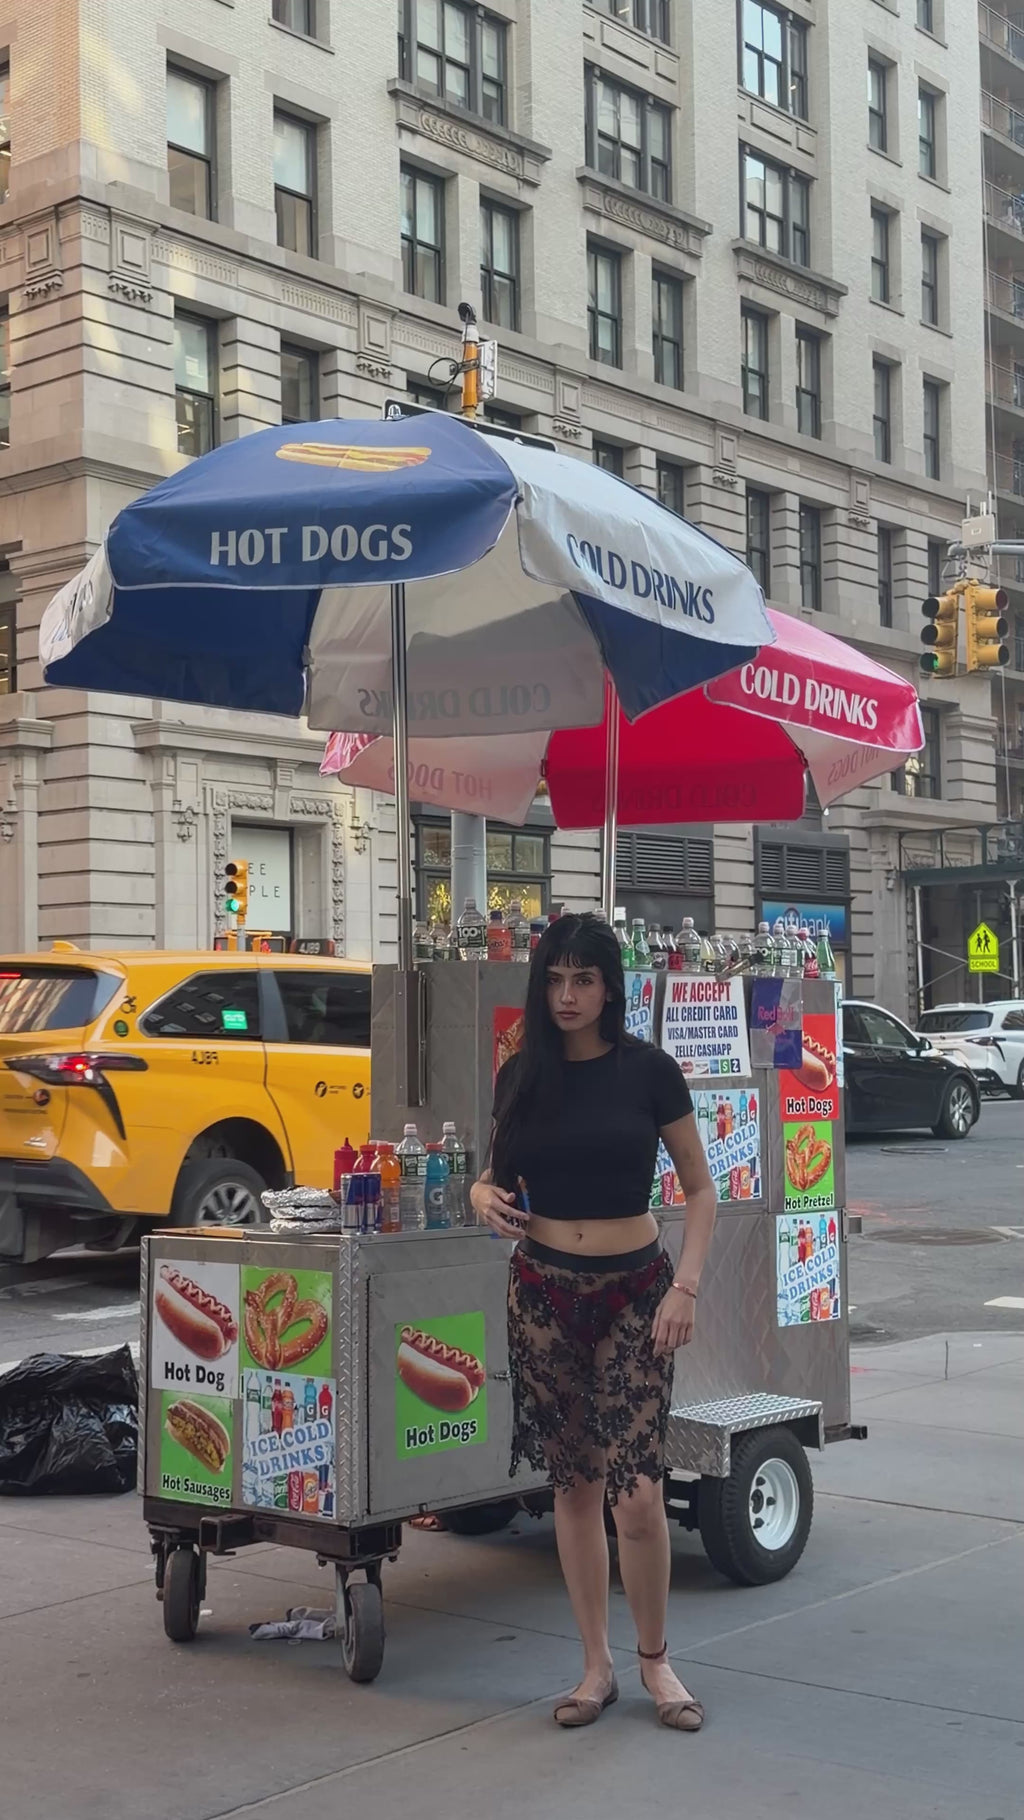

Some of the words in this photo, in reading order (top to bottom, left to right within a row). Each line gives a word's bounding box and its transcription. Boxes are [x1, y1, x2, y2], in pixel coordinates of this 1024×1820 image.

[209, 527, 288, 567] HOT
[302, 524, 414, 562] DOGS
[565, 533, 627, 590] COLD
[631, 560, 716, 625] DRINKS
[740, 663, 800, 707] COLD
[804, 678, 879, 731] DRINKS
[971, 960, 997, 969] SCHOOL
[672, 982, 688, 1003] WE
[689, 981, 731, 1003] ACCEPT
[625, 1009, 649, 1030] OLD
[665, 1006, 679, 1022] ALL
[681, 1006, 711, 1022] CREDIT
[713, 1005, 738, 1021] CARD
[667, 1026, 716, 1040] VISA/MASTER
[717, 1025, 739, 1038] CARD
[675, 1043, 732, 1058] ZELLE/CASHAPP
[787, 1098, 806, 1113] Hot
[808, 1097, 833, 1116] Dogs
[707, 1141, 724, 1160] CE
[725, 1123, 756, 1150] COLD
[709, 1142, 754, 1178] DRINKS
[429, 1187, 444, 1206] G
[785, 1197, 801, 1210] Hot
[803, 1193, 834, 1209] Pretzel
[782, 1264, 804, 1287] ICE
[806, 1245, 835, 1273] COLD
[789, 1263, 833, 1300] DRINKS
[164, 1361, 191, 1382] Hot
[195, 1364, 225, 1392] Dog
[251, 1434, 280, 1457] ICE
[283, 1422, 330, 1448] COLD
[406, 1424, 435, 1448] Hot
[440, 1420, 477, 1442] Dogs
[258, 1444, 326, 1476] DRINKS
[162, 1474, 181, 1491] Hot
[184, 1478, 231, 1502] Sausages
